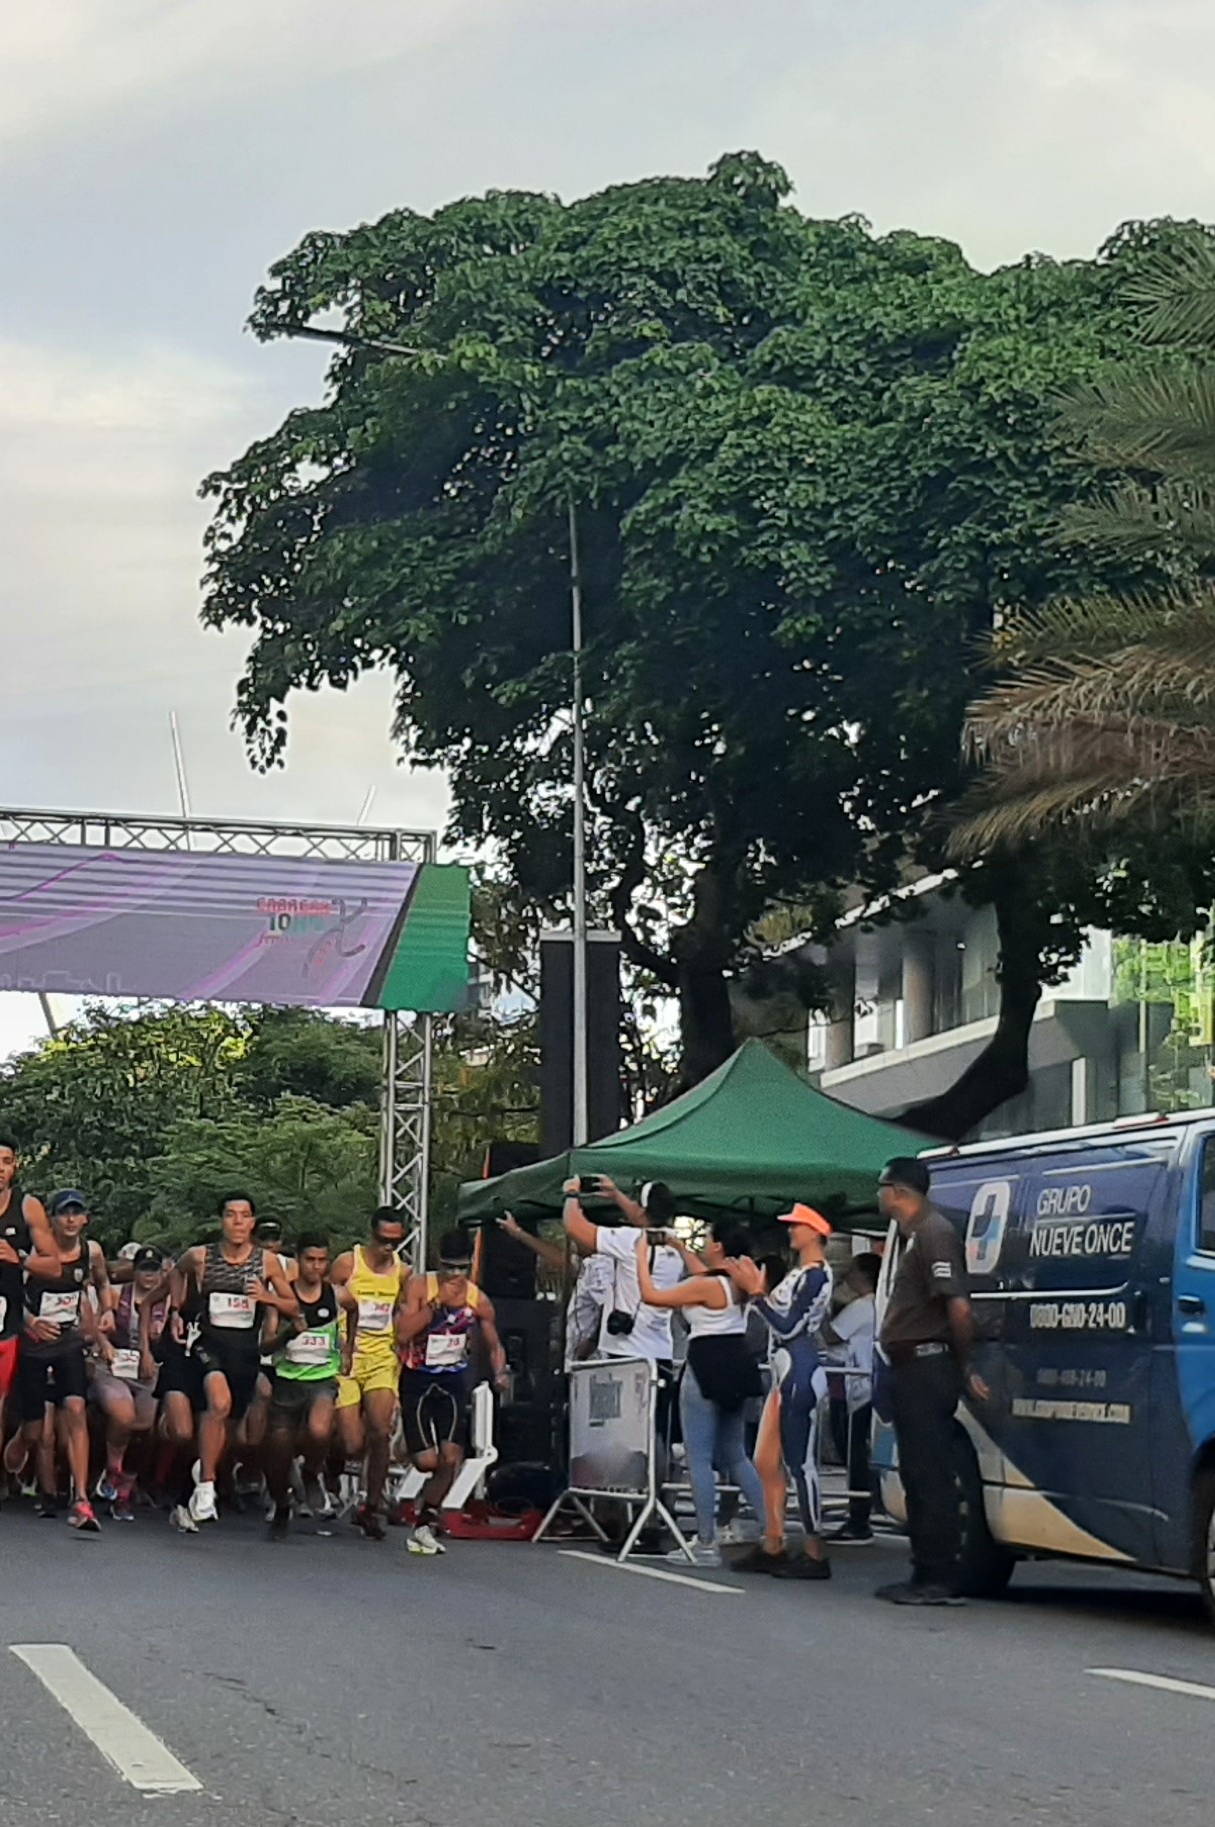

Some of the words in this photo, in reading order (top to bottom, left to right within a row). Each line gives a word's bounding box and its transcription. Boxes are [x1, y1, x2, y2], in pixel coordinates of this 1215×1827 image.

[1037, 1184, 1091, 1216] GRUPO
[1029, 1226, 1083, 1257] NUEVE
[1084, 1221, 1135, 1253] ONCE
